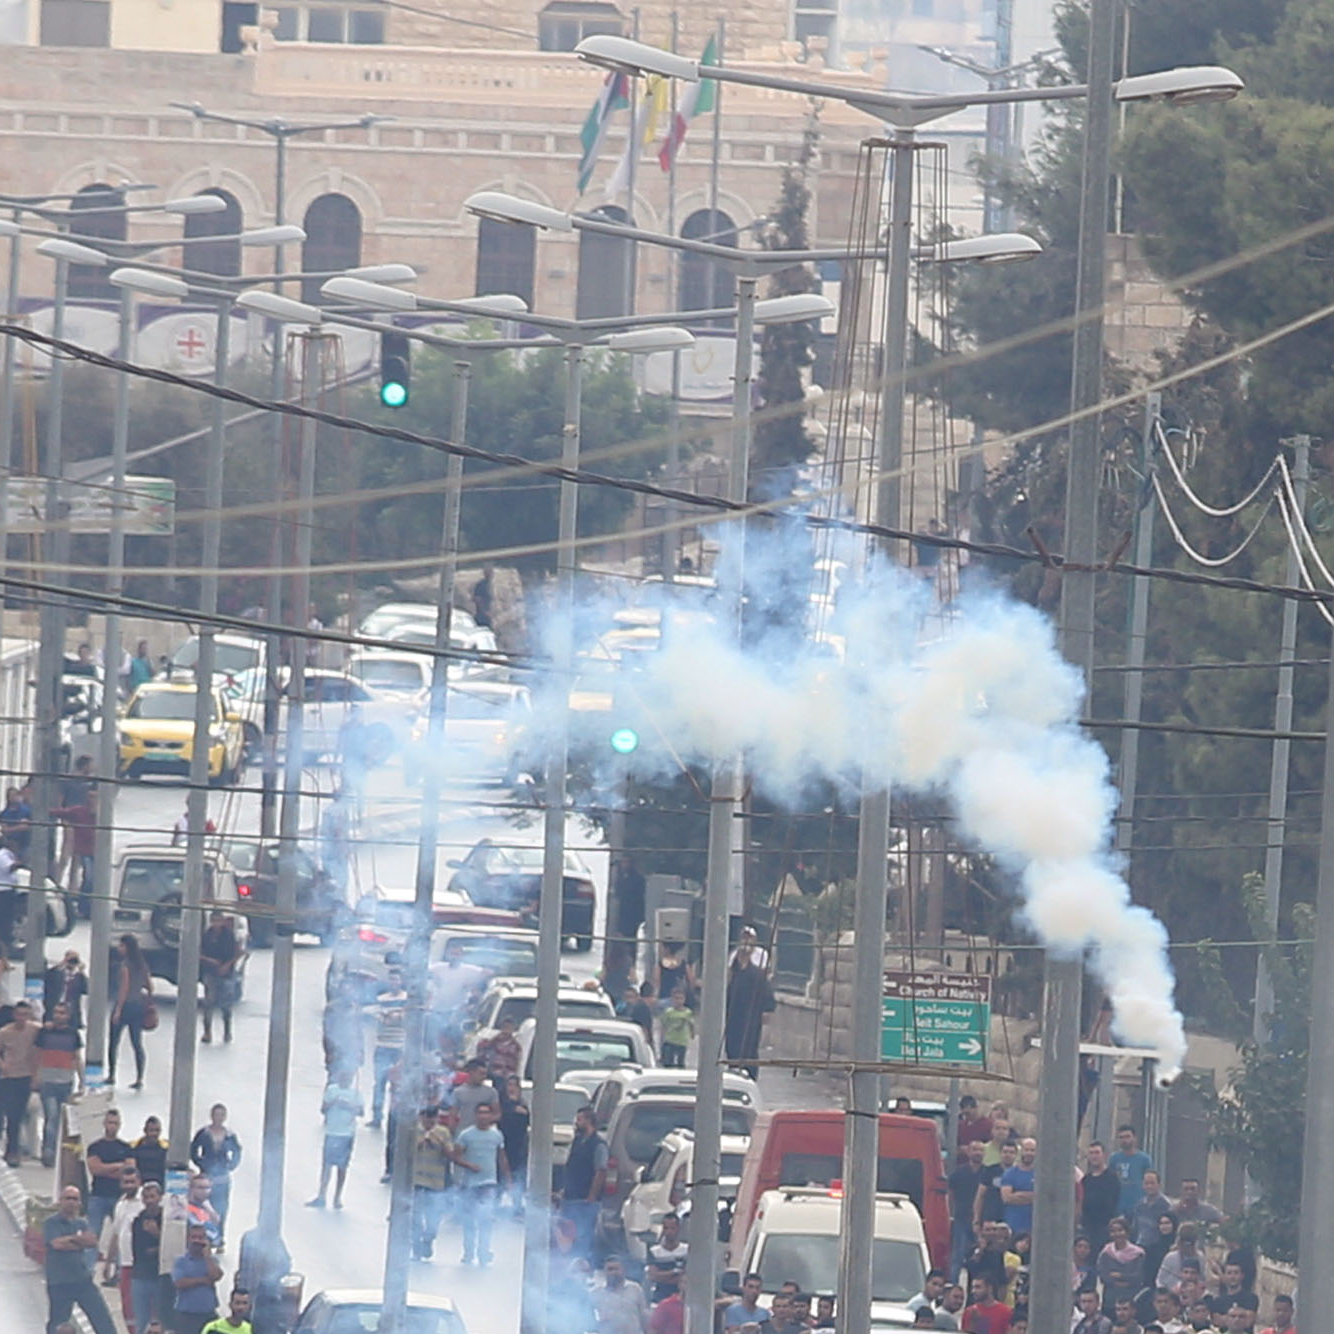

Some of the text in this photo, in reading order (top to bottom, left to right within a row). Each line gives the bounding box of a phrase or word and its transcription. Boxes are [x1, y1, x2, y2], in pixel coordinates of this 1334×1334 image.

[898, 985, 987, 1003] Church of Nativy
[934, 1018, 971, 1030] Sahour
